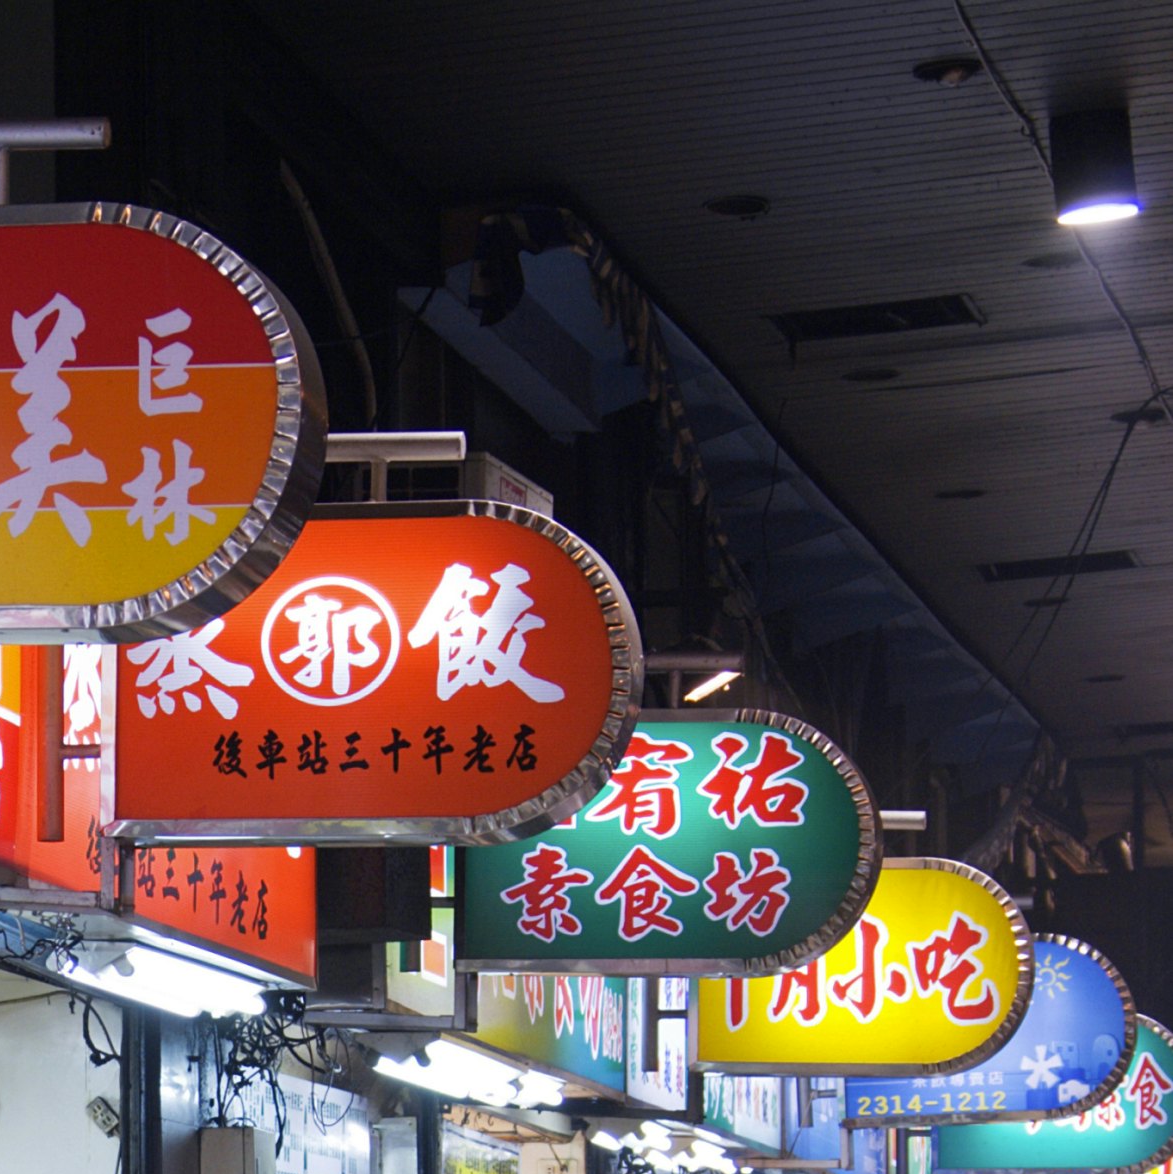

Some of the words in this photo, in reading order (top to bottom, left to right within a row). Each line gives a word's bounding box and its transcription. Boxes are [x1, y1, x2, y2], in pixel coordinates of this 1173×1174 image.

[120, 308, 217, 547] 巨林
[212, 726, 540, 779] 後車站三十年老店
[499, 842, 793, 943] 素食坊
[857, 1090, 1008, 1116] 2314-1212
